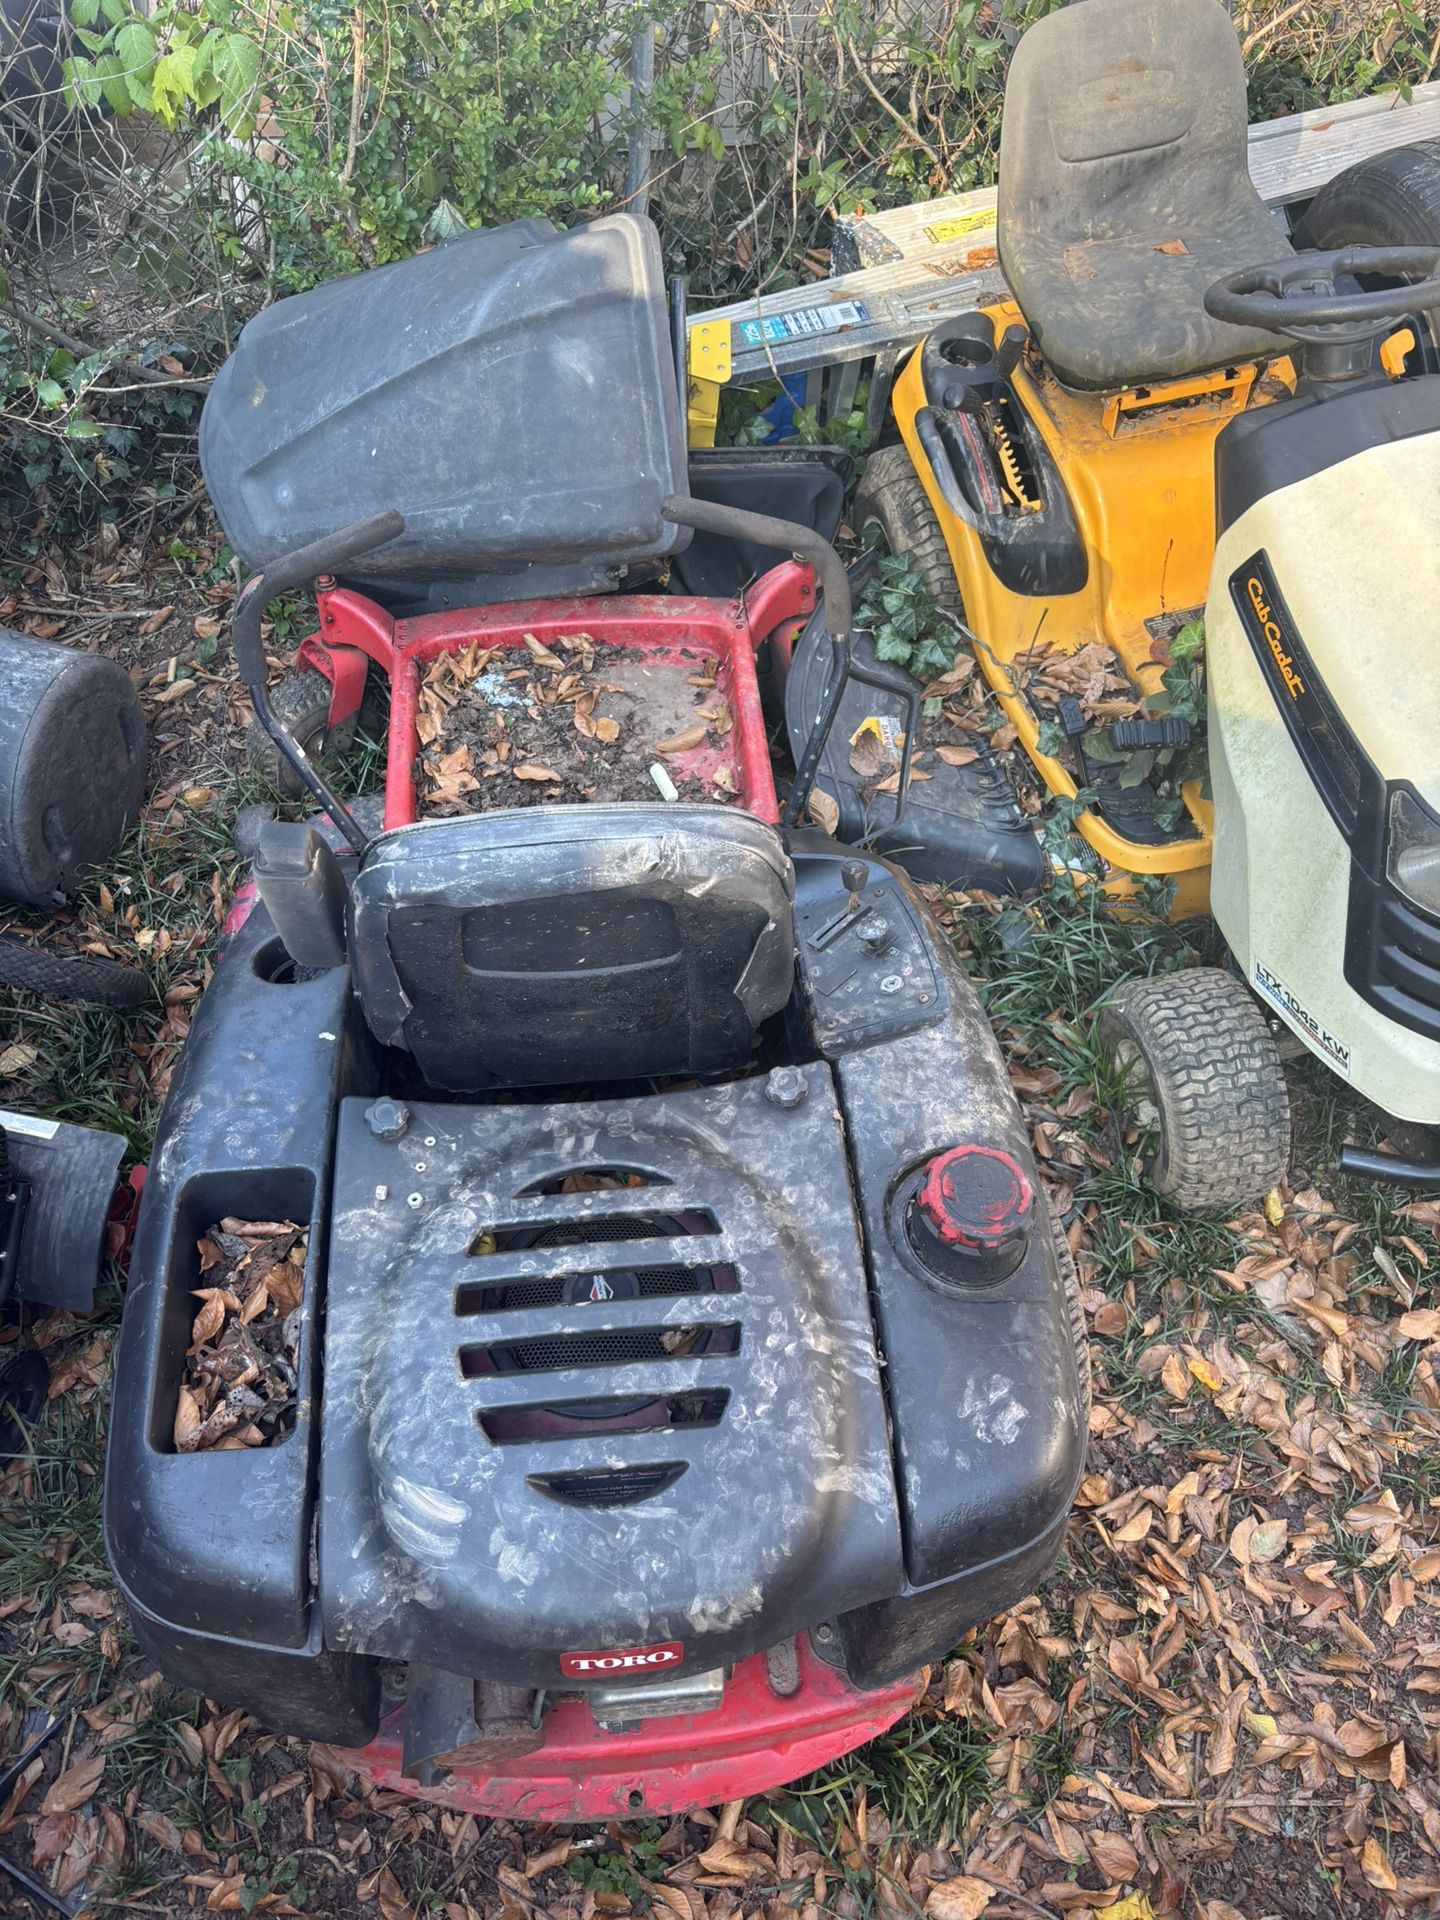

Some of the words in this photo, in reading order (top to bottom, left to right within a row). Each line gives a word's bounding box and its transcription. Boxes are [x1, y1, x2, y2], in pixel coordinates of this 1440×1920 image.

[1247, 577, 1270, 623] Cub
[1264, 622, 1305, 699] Cadet
[1257, 963, 1282, 994] LTX
[1284, 991, 1320, 1035] 1042
[1322, 1031, 1349, 1060] KW
[571, 1650, 676, 1670] TORO
